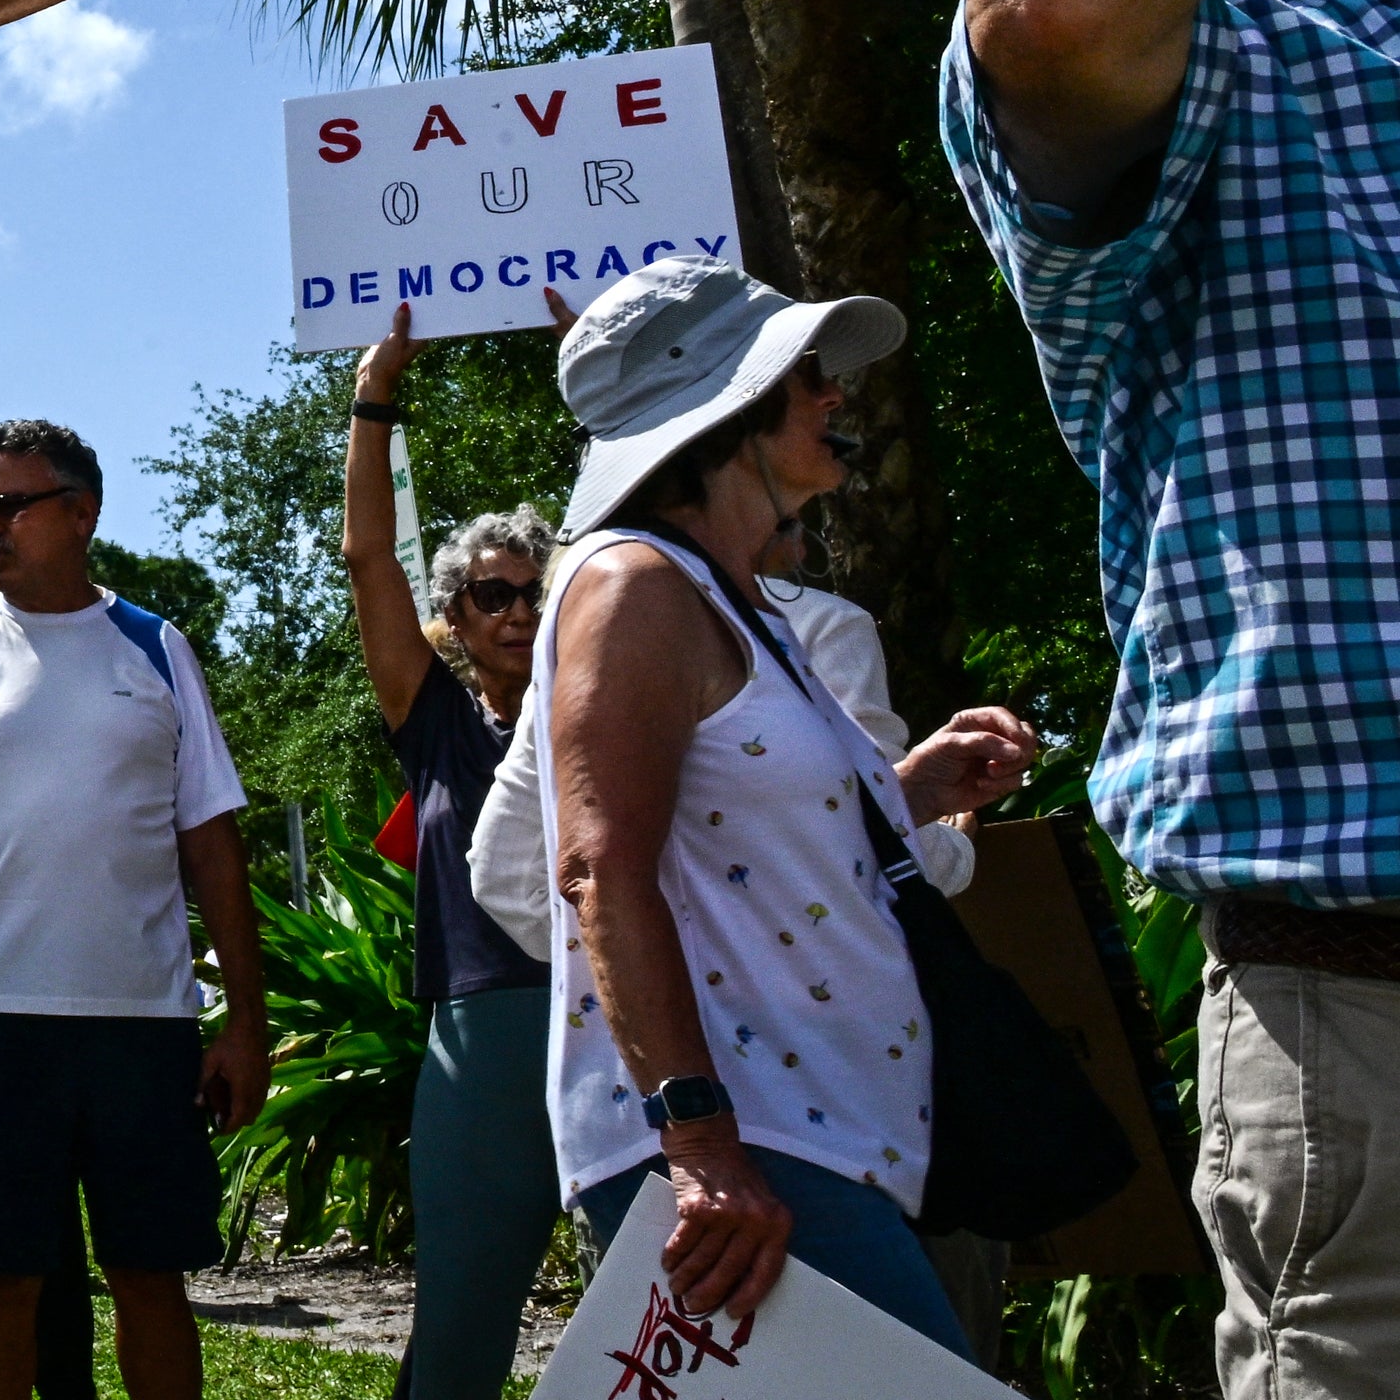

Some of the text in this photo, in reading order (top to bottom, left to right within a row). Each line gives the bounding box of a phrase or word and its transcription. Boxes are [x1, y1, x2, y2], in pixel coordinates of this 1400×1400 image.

[318, 79, 667, 163] SAVE
[381, 158, 640, 226] OUR
[303, 235, 727, 309] DEMOCRACY
